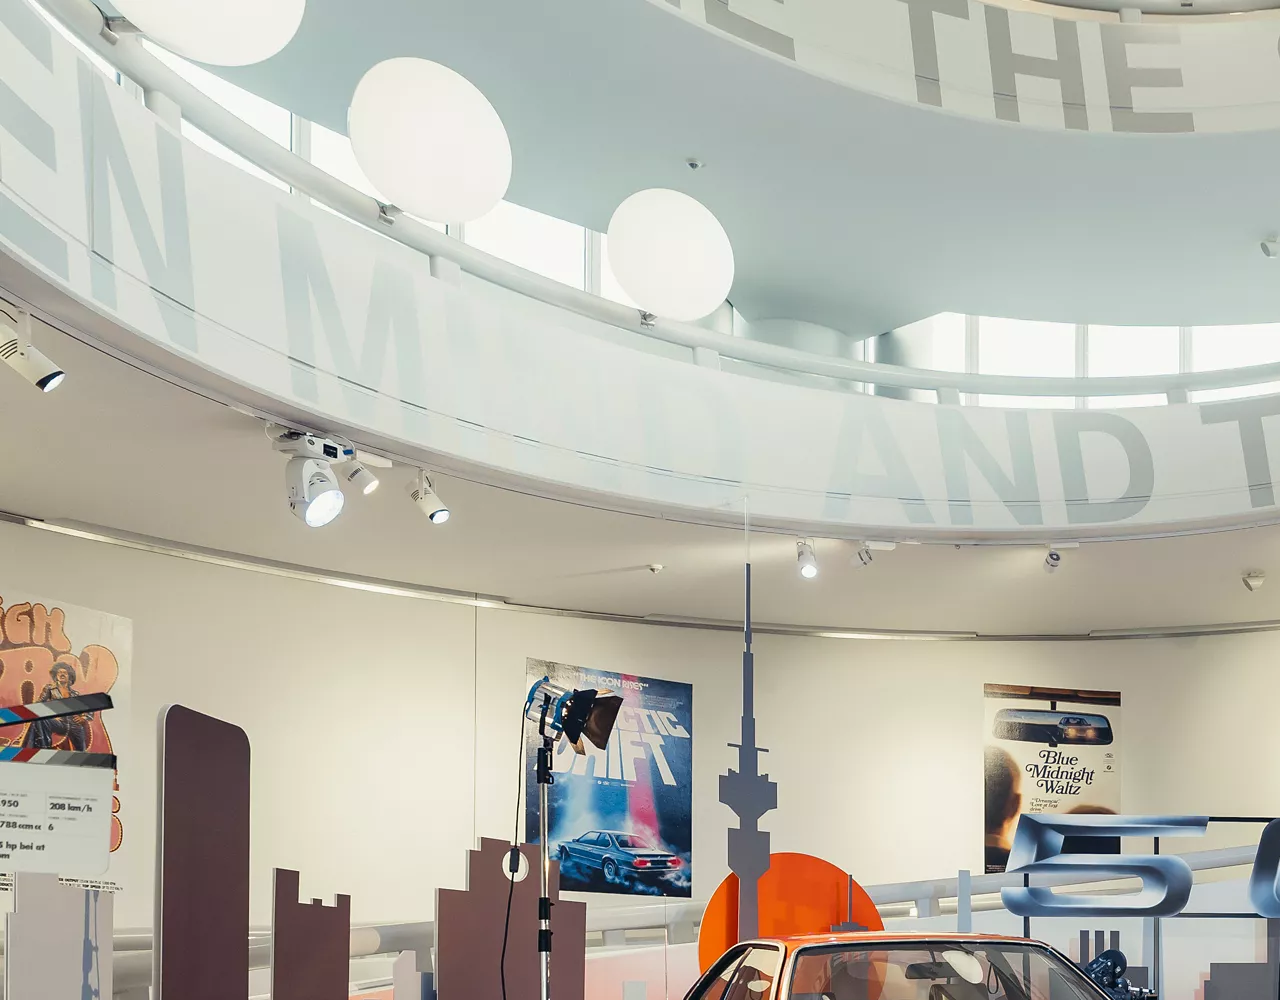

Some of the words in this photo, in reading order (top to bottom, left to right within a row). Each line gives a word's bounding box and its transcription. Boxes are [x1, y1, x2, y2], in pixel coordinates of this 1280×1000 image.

[900, 0, 1195, 133] THE
[824, 408, 1155, 526] AND
[598, 675, 621, 687] ICON
[612, 705, 691, 738] CTIC
[1038, 749, 1079, 766] Blue
[1025, 763, 1096, 786] Midnight
[1036, 779, 1082, 796] Waltz
[49, 802, 66, 811] 208
[67, 803, 93, 813] km/h
[48, 823, 54, 831] 6
[6, 841, 17, 851] hp
